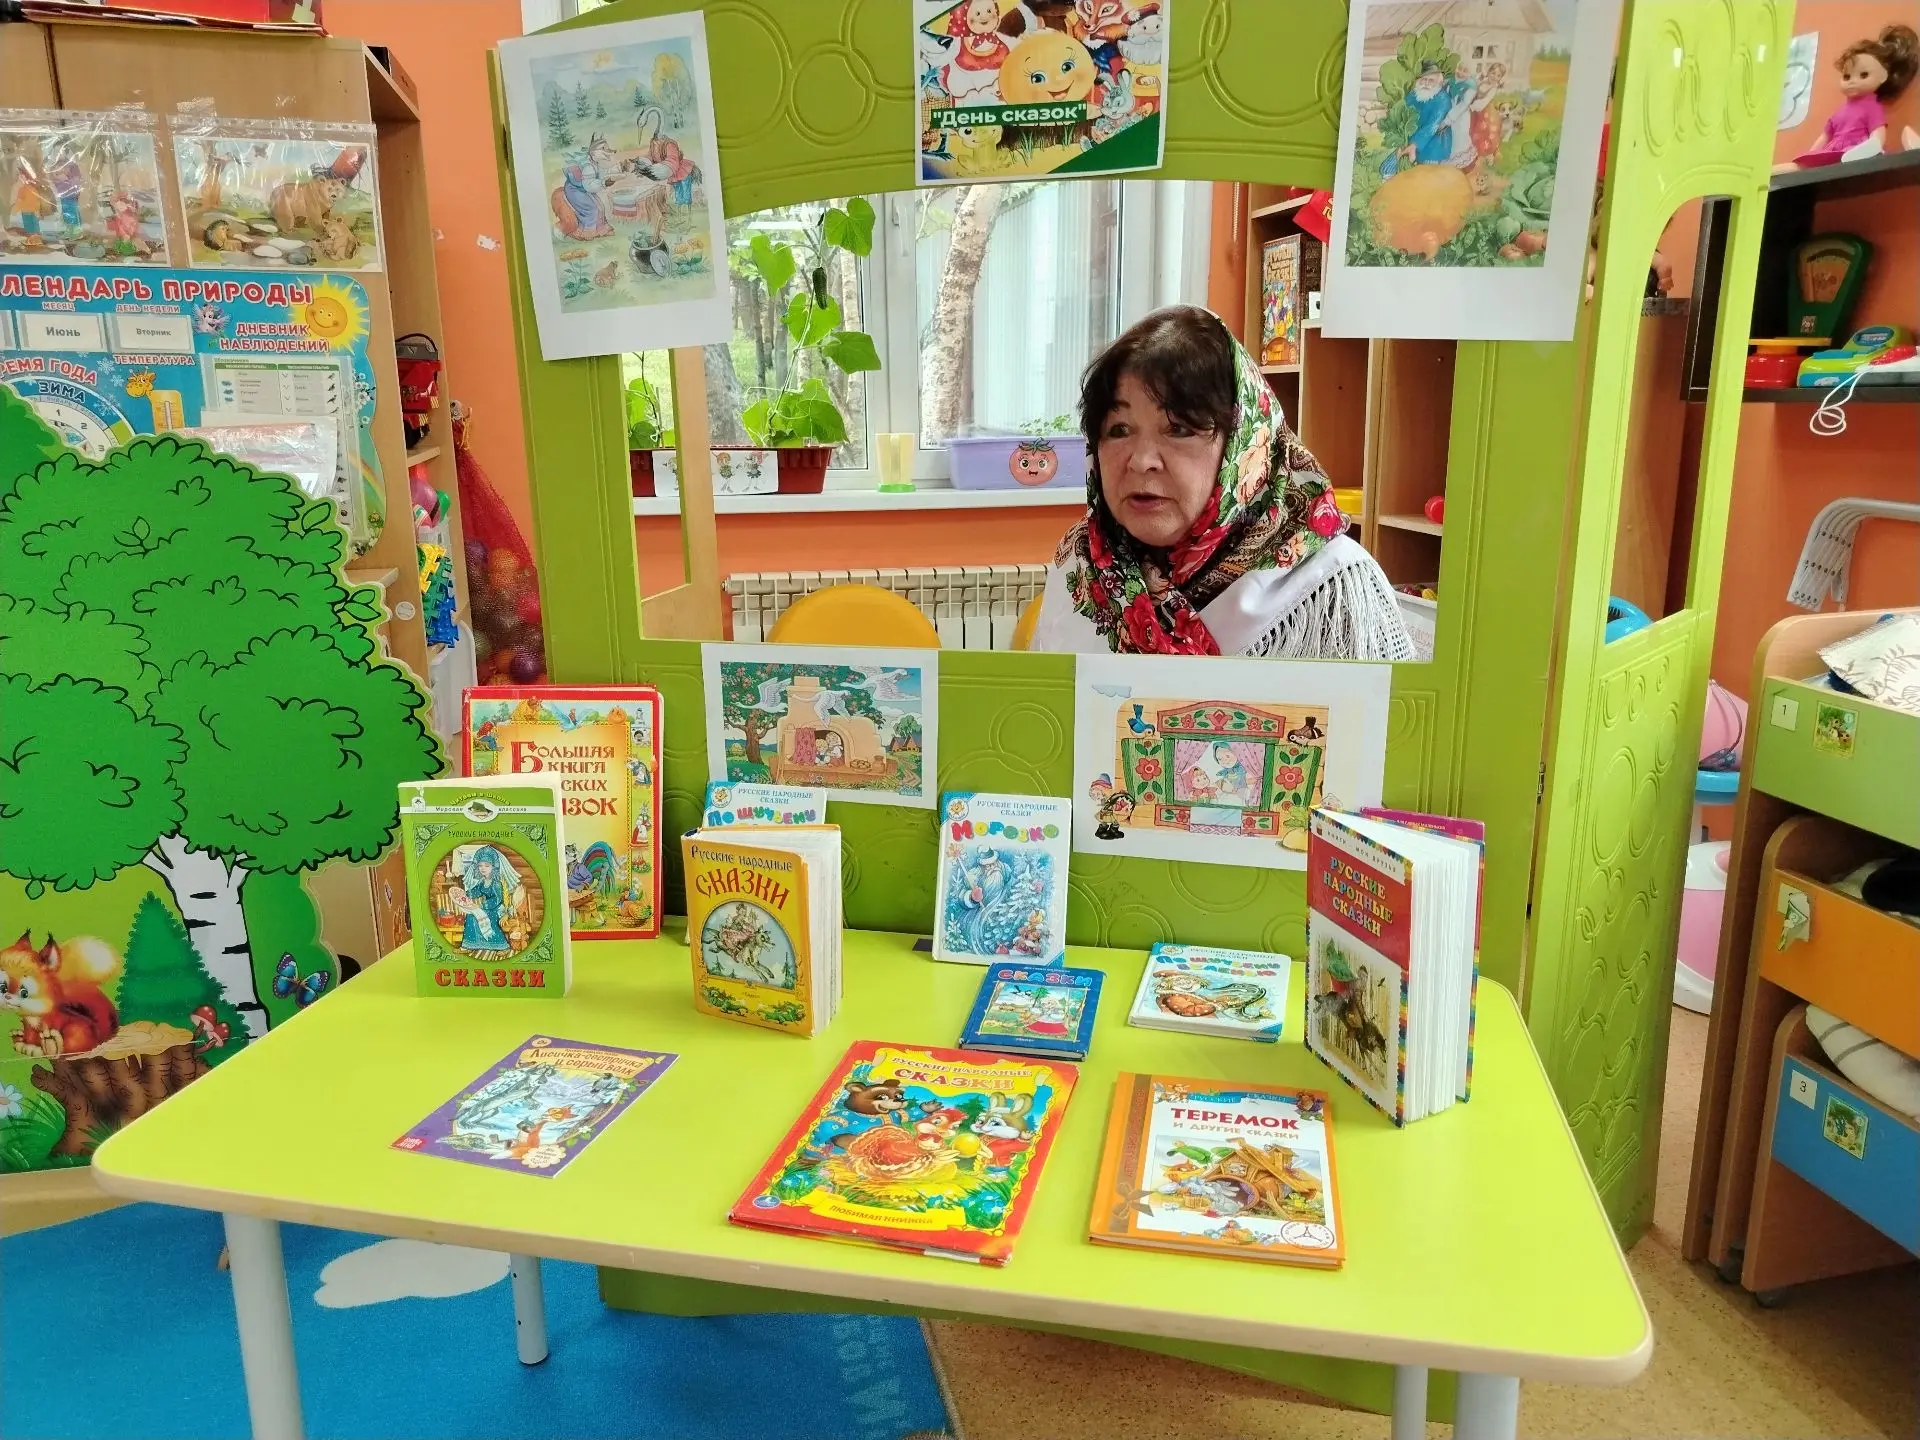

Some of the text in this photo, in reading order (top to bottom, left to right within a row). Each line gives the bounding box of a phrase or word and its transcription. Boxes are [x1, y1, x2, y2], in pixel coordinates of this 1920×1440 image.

[933, 104, 1087, 127] "День сказок"
[1, 275, 313, 306] ЛЕНДАРЬ ПРИРОДЫ
[42, 302, 75, 311] МЕСЯЦ
[116, 304, 180, 313] ДЕНЬ НЕДЕЛИ
[46, 327, 81, 337] Июнь
[136, 328, 172, 336] Вторник
[236, 323, 310, 337] ДНЕВНИК
[220, 338, 330, 352] НАБЛЮДЕНИЙ
[114, 354, 195, 365] ТЕМПЕРАТУРА
[0, 357, 98, 385] ЕМЯ ГОДА
[38, 381, 86, 403] ЗИМА
[1782, 704, 1787, 715] 1
[561, 780, 607, 791] ских
[738, 788, 813, 799] РУССКИЕ НАРОДНЫЕ
[562, 797, 618, 816] ЗОК
[977, 800, 1058, 811] РУССКИЕ НАРОДНЫЕ
[1000, 809, 1032, 817] СКАЗКИ
[707, 810, 735, 827] ПО
[951, 820, 1059, 843] МОРОЗКО
[691, 844, 793, 872] Русские народные
[1330, 856, 1386, 900] РУССКИЕ
[695, 867, 791, 911] СКАЗКИ
[1323, 870, 1393, 924] НАРОДНЫЕ
[1332, 896, 1382, 937] СКАЗКИ
[434, 968, 545, 988] СКАЗКИ
[998, 969, 1092, 986] СКАЗКИ
[892, 1057, 1032, 1077] РУССКИЕ НАРОДНЫЕ
[894, 1068, 1014, 1090] СКАЗКИ
[1800, 1081, 1807, 1093] 3
[1171, 1108, 1299, 1130] ТЕРЕМОК
[1189, 1123, 1240, 1134] ДРУГИЕ
[1246, 1129, 1299, 1140] СКАЗКИ
